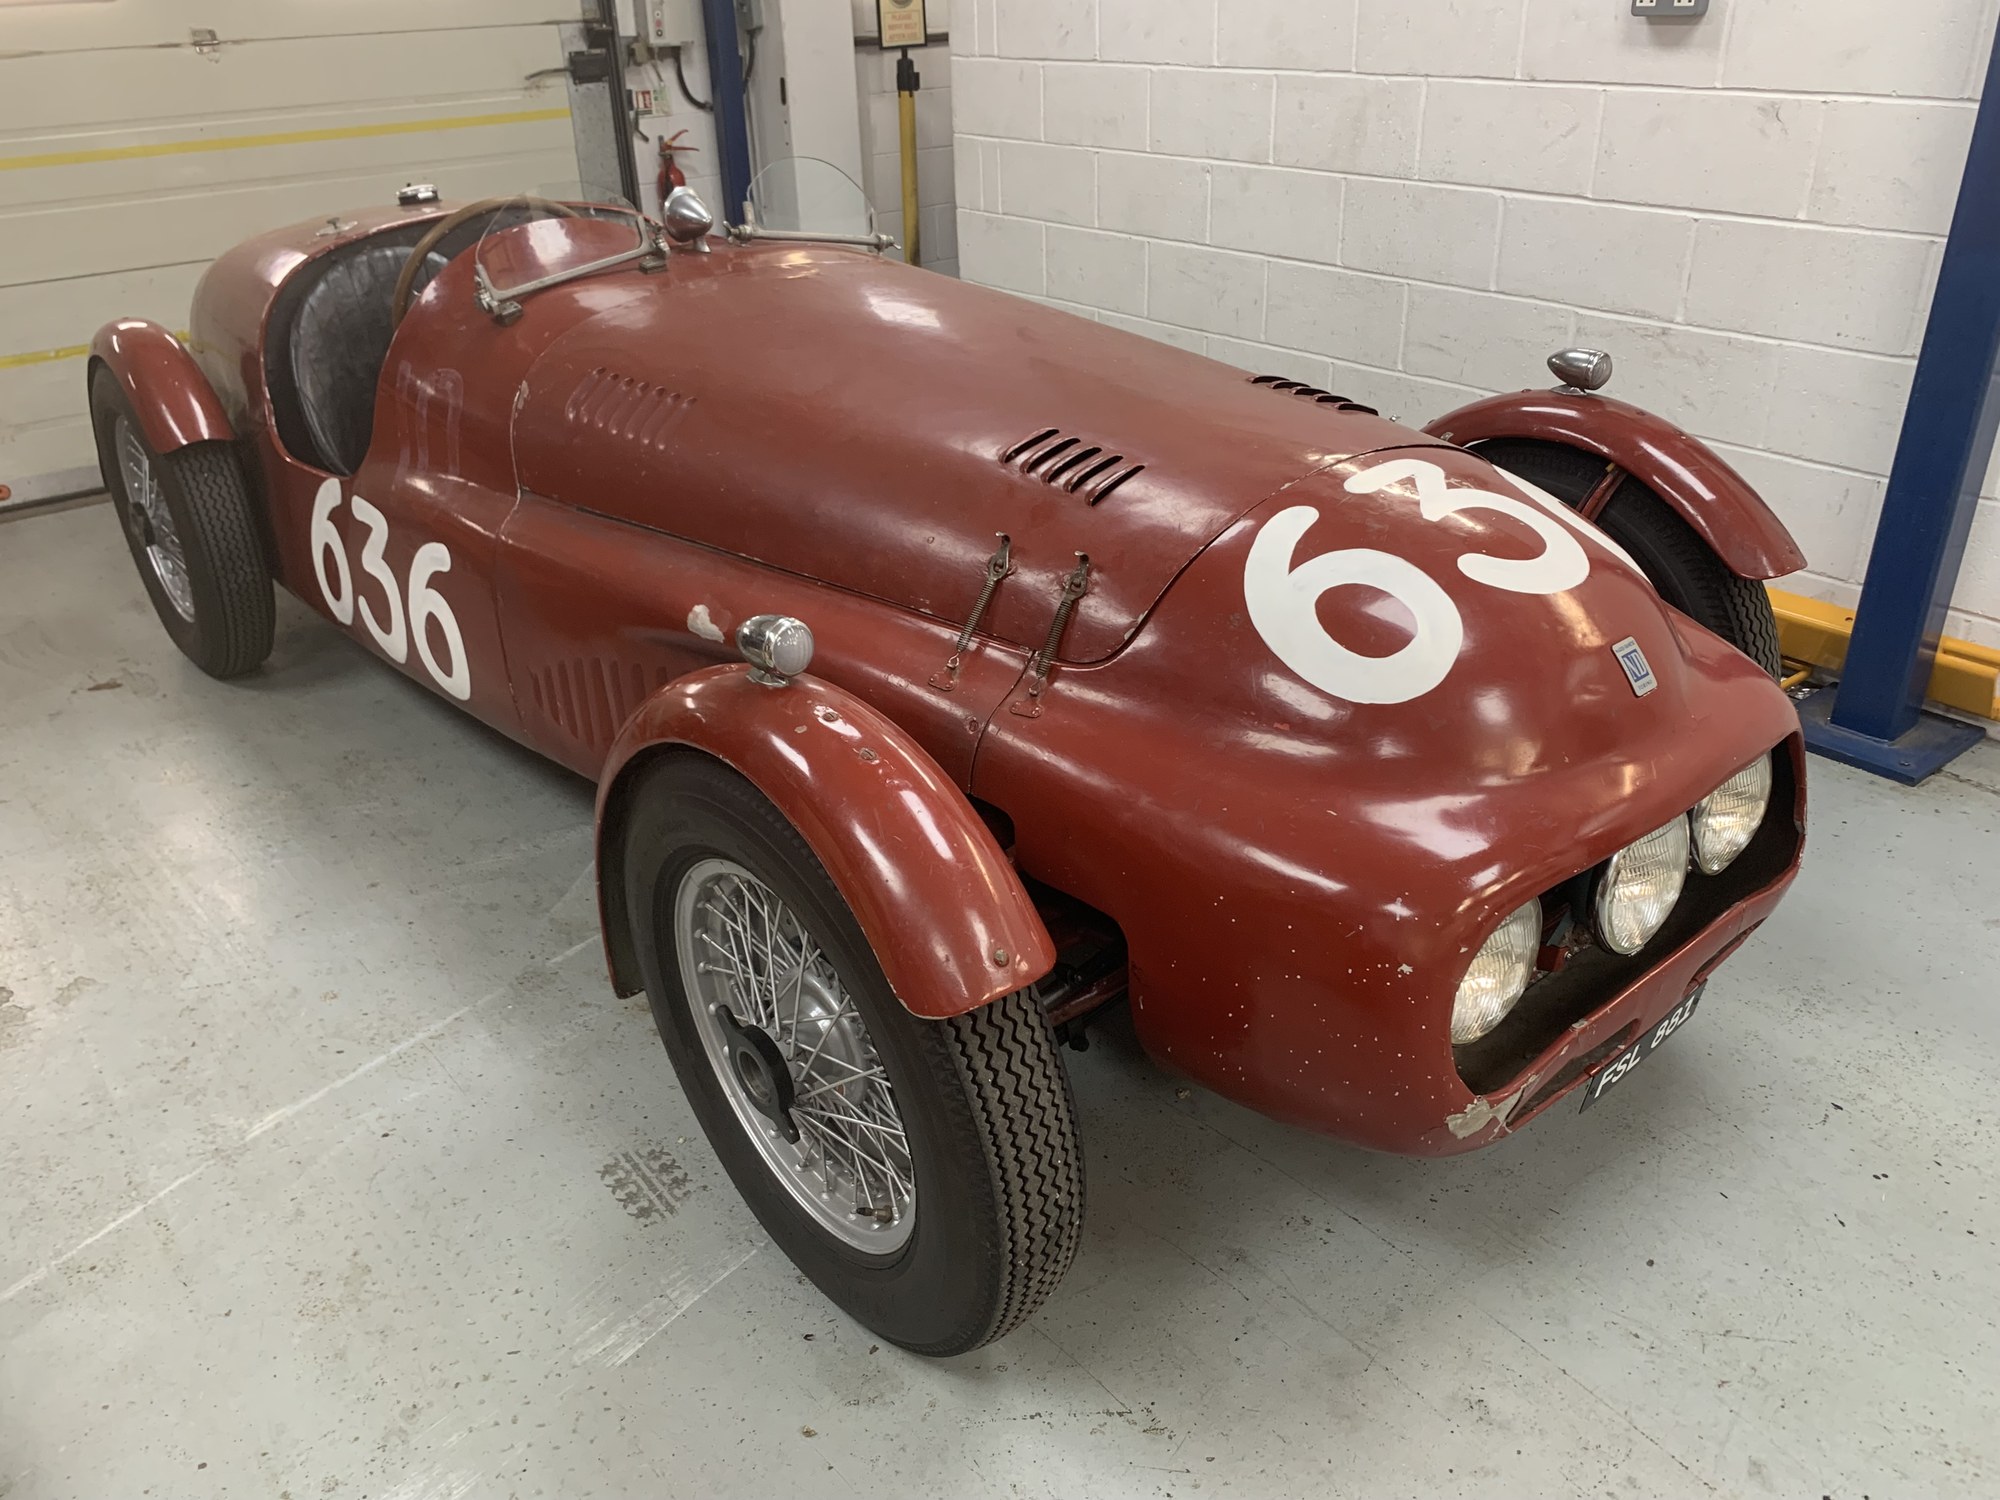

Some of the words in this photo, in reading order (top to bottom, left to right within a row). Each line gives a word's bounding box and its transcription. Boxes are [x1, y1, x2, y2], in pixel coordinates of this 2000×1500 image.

[311, 477, 471, 701] 636
[1244, 459, 1653, 704] 63
[1594, 1043, 1641, 1099] FSL
[1650, 995, 1695, 1049] 881
